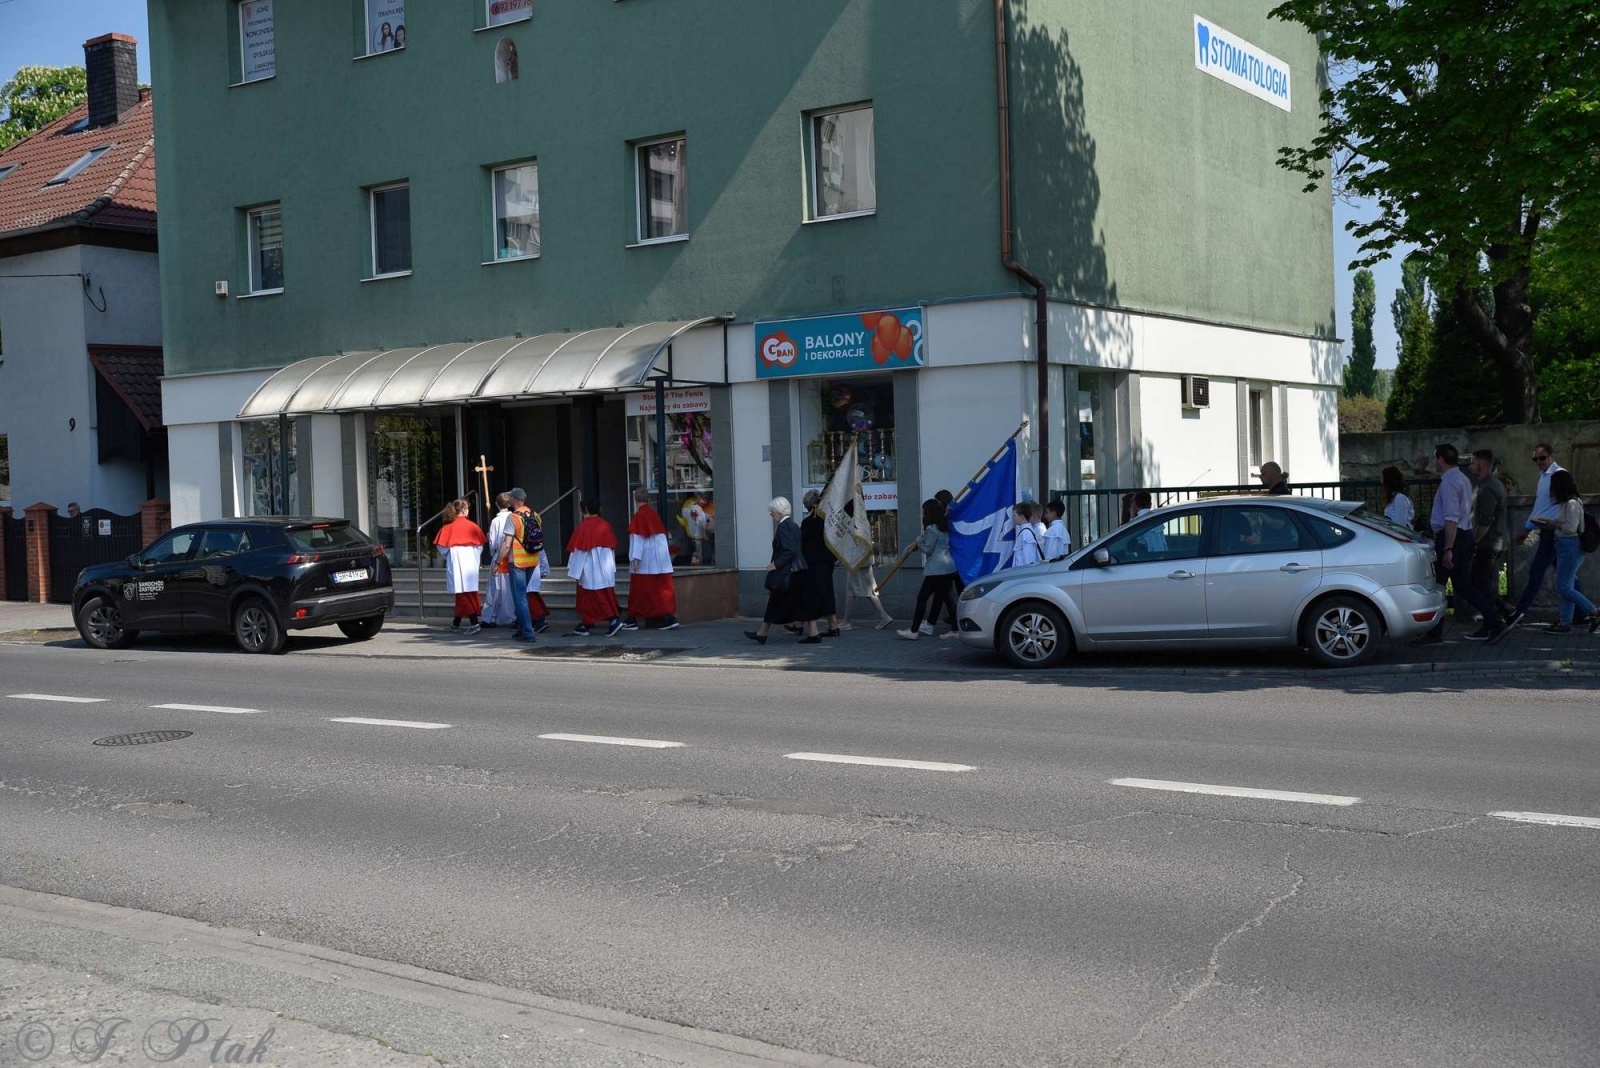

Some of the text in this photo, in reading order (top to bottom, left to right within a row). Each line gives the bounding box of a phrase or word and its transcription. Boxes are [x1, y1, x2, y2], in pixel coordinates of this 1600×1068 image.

[1211, 36, 1288, 100] STOMATOLOGIA
[805, 331, 865, 349] BALONY
[805, 347, 865, 361] I DEKORACJE
[683, 401, 708, 409] zabawy
[69, 417, 76, 431] 9
